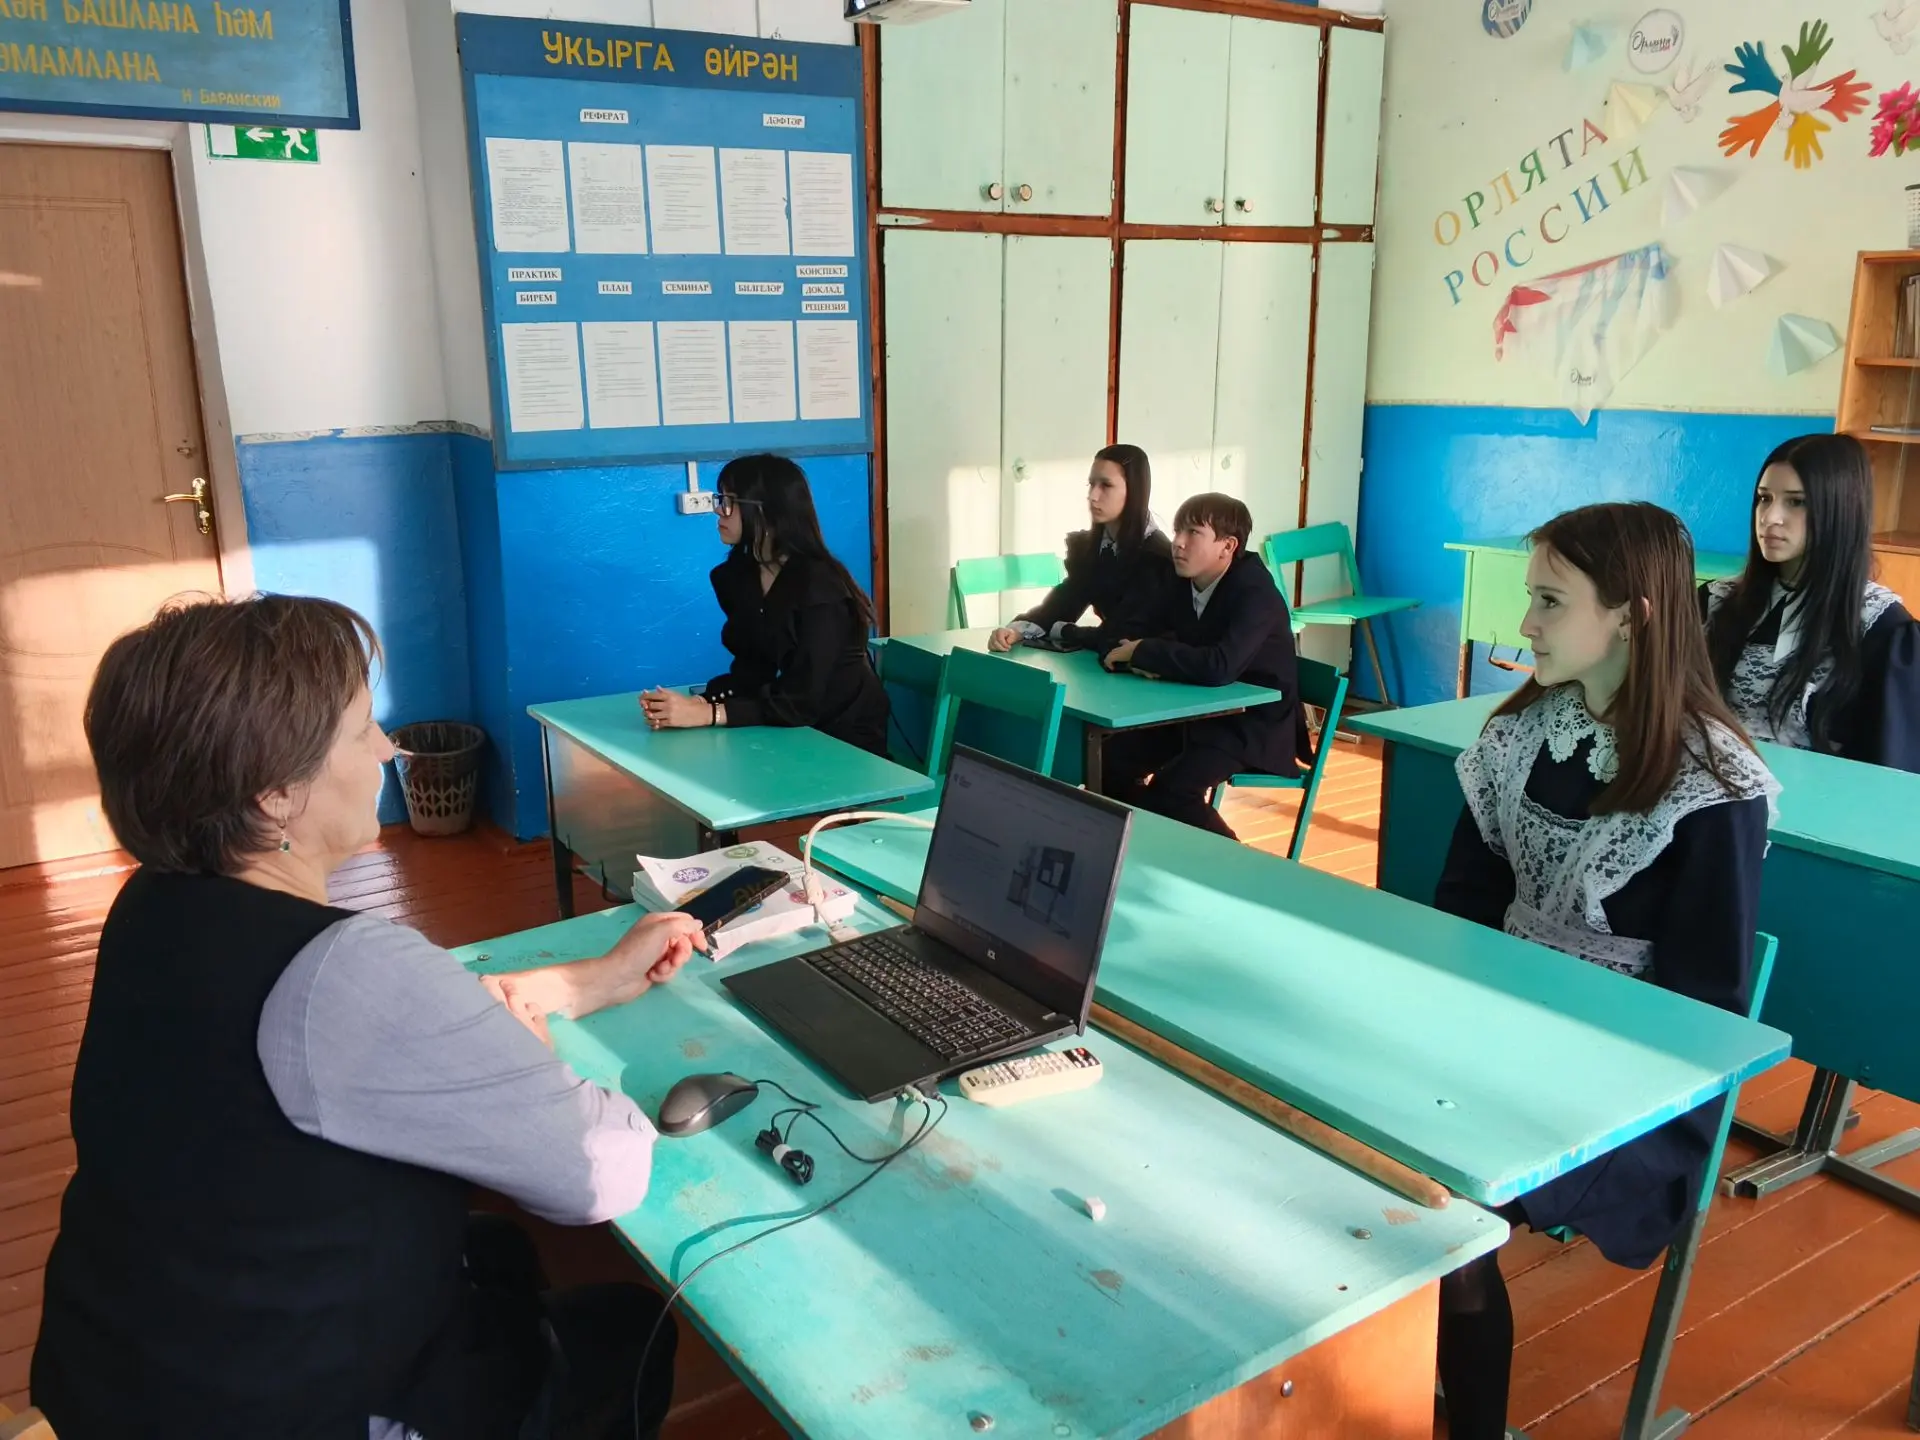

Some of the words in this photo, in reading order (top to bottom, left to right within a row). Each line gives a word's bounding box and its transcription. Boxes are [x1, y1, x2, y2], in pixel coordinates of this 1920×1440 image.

[542, 30, 675, 72] УКЫРГА
[704, 43, 798, 82] ӨЙРӘН
[583, 111, 626, 122] РЕФЕРАТ
[765, 116, 803, 127] ДӘФТӘР
[1433, 117, 1609, 246] ОРЛЯТА
[1443, 145, 1652, 307] РОССИИ
[511, 270, 558, 279] ПРАКТИК
[601, 284, 630, 292] ПЛАН
[665, 283, 710, 292] СЕМИНАР
[519, 294, 554, 302] БИРЕМ
[804, 303, 847, 312] РЕЦЕНЗИЯ
